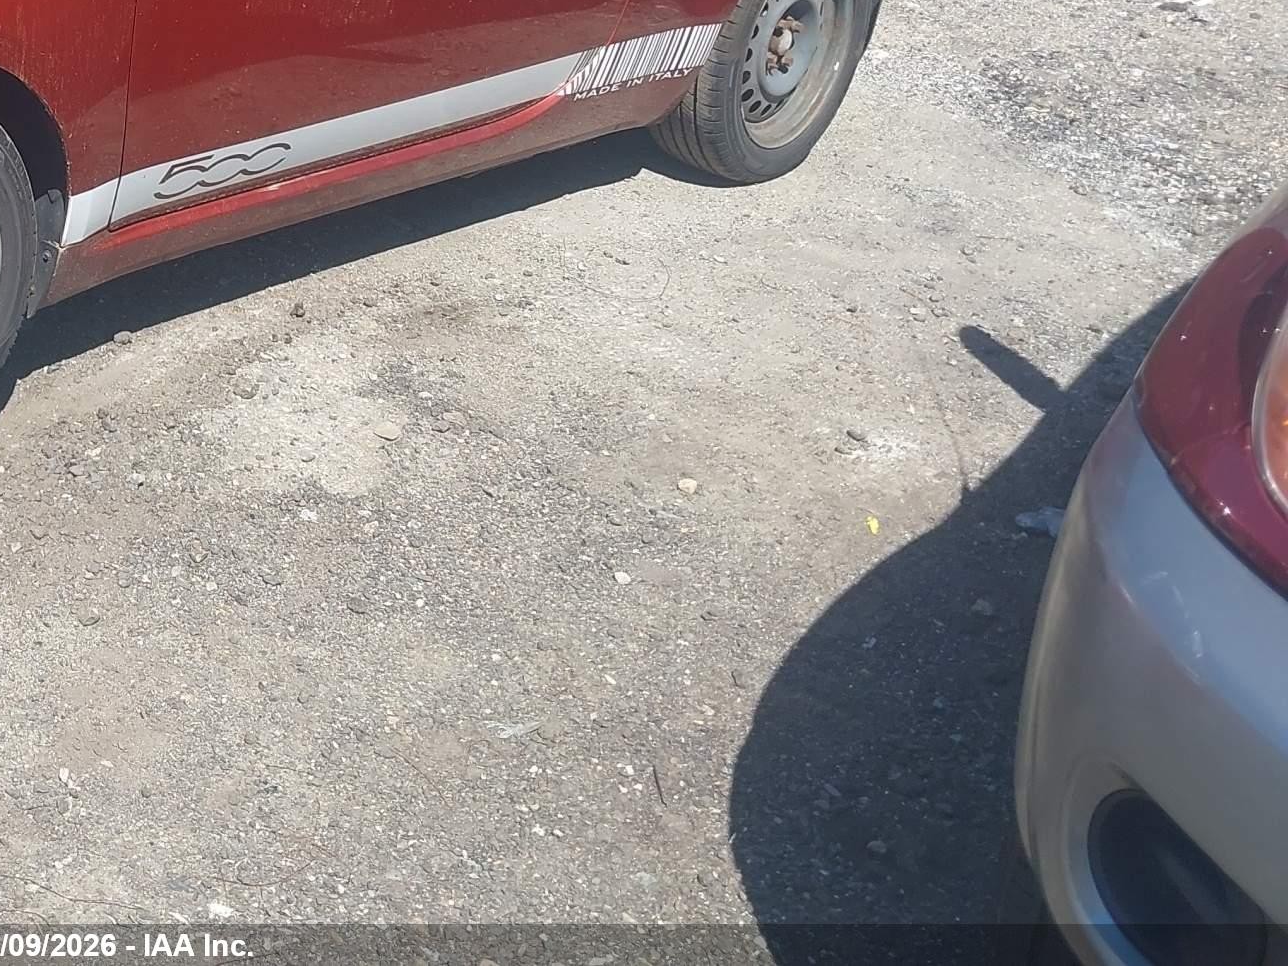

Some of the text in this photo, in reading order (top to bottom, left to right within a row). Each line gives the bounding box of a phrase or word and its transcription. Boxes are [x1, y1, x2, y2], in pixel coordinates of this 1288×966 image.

[574, 67, 694, 102] MADE IN ITALY
[153, 142, 292, 200] 500
